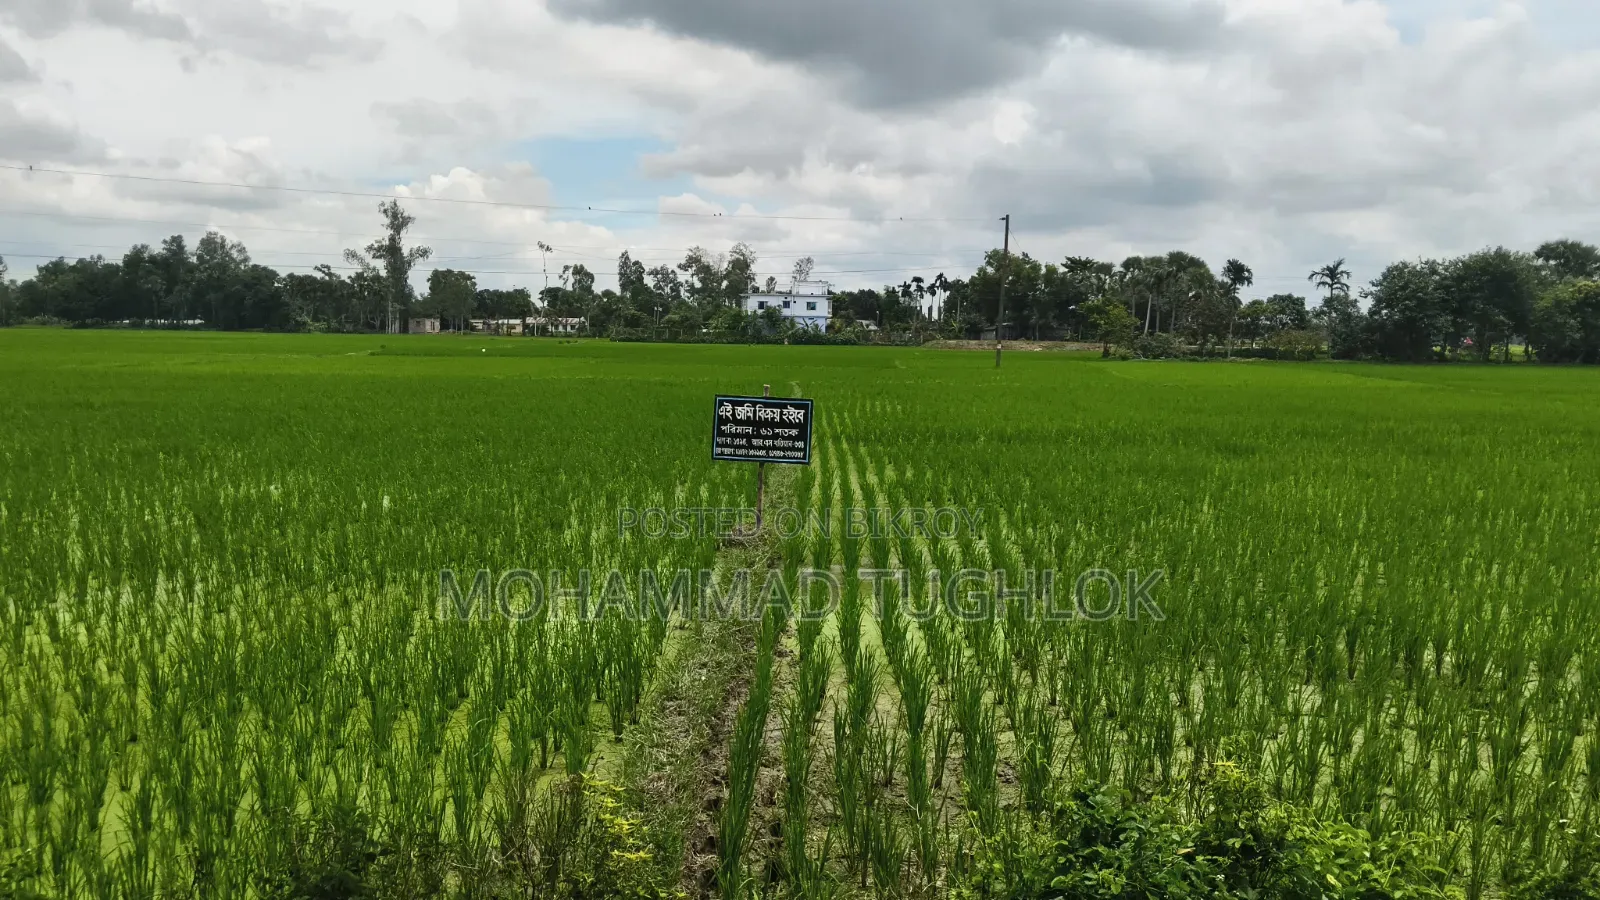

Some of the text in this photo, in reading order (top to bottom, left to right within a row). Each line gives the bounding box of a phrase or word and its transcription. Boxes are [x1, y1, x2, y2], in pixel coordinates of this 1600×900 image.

[719, 402, 805, 424] এই জমি বিক্রয় হইবে
[760, 427, 773, 436] ৬১
[774, 428, 799, 437] শতক
